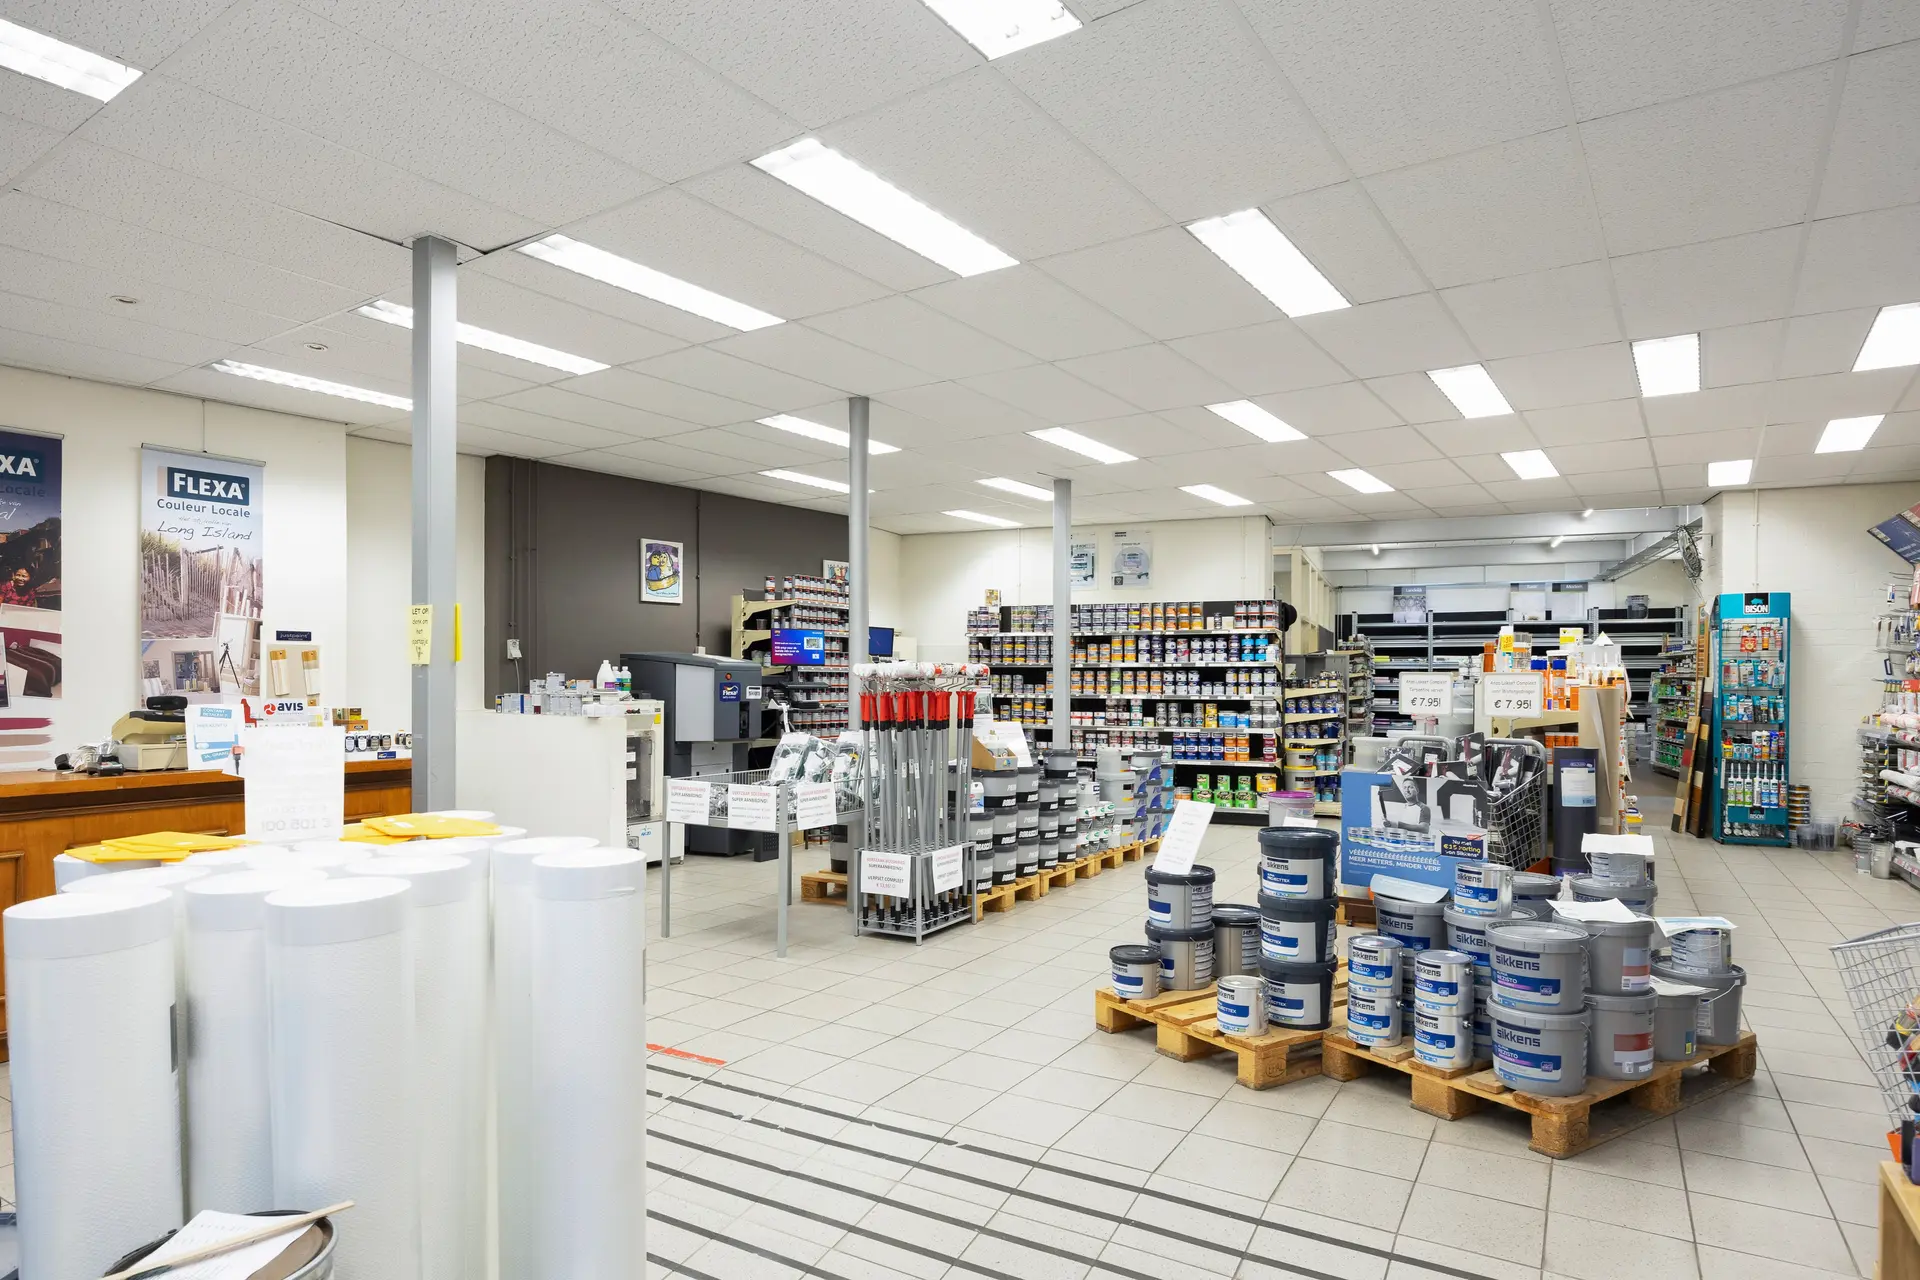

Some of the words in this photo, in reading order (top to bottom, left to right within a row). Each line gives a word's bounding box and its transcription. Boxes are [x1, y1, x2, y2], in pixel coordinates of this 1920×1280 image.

[157, 498, 207, 513] Couleur
[211, 504, 251, 518] Locale
[157, 520, 195, 541] Long
[202, 526, 253, 541] Island
[1745, 604, 1768, 613] BISON
[278, 702, 304, 712] avis
[1410, 697, 1418, 706] €
[1419, 697, 1441, 707] 7.95!
[1494, 700, 1502, 709] €
[1506, 699, 1532, 710] 7.95!
[1266, 861, 1289, 871] sikkens
[1348, 855, 1367, 864] MEER
[1367, 857, 1395, 867] METERS,
[1396, 861, 1422, 870] MINDER
[1423, 864, 1441, 872] VERF
[1457, 873, 1482, 883] sikkens
[1379, 915, 1414, 931] sikkens
[1352, 950, 1379, 962] sikkens
[1495, 954, 1540, 971] sikkens
[1416, 966, 1441, 977] sikkens
[1496, 975, 1518, 984] REZISTO
[1350, 1000, 1376, 1011] sikkens
[1415, 1016, 1439, 1029] sikkens
[1496, 1028, 1541, 1048] sikkens
[1497, 1048, 1519, 1060] REZISTO
